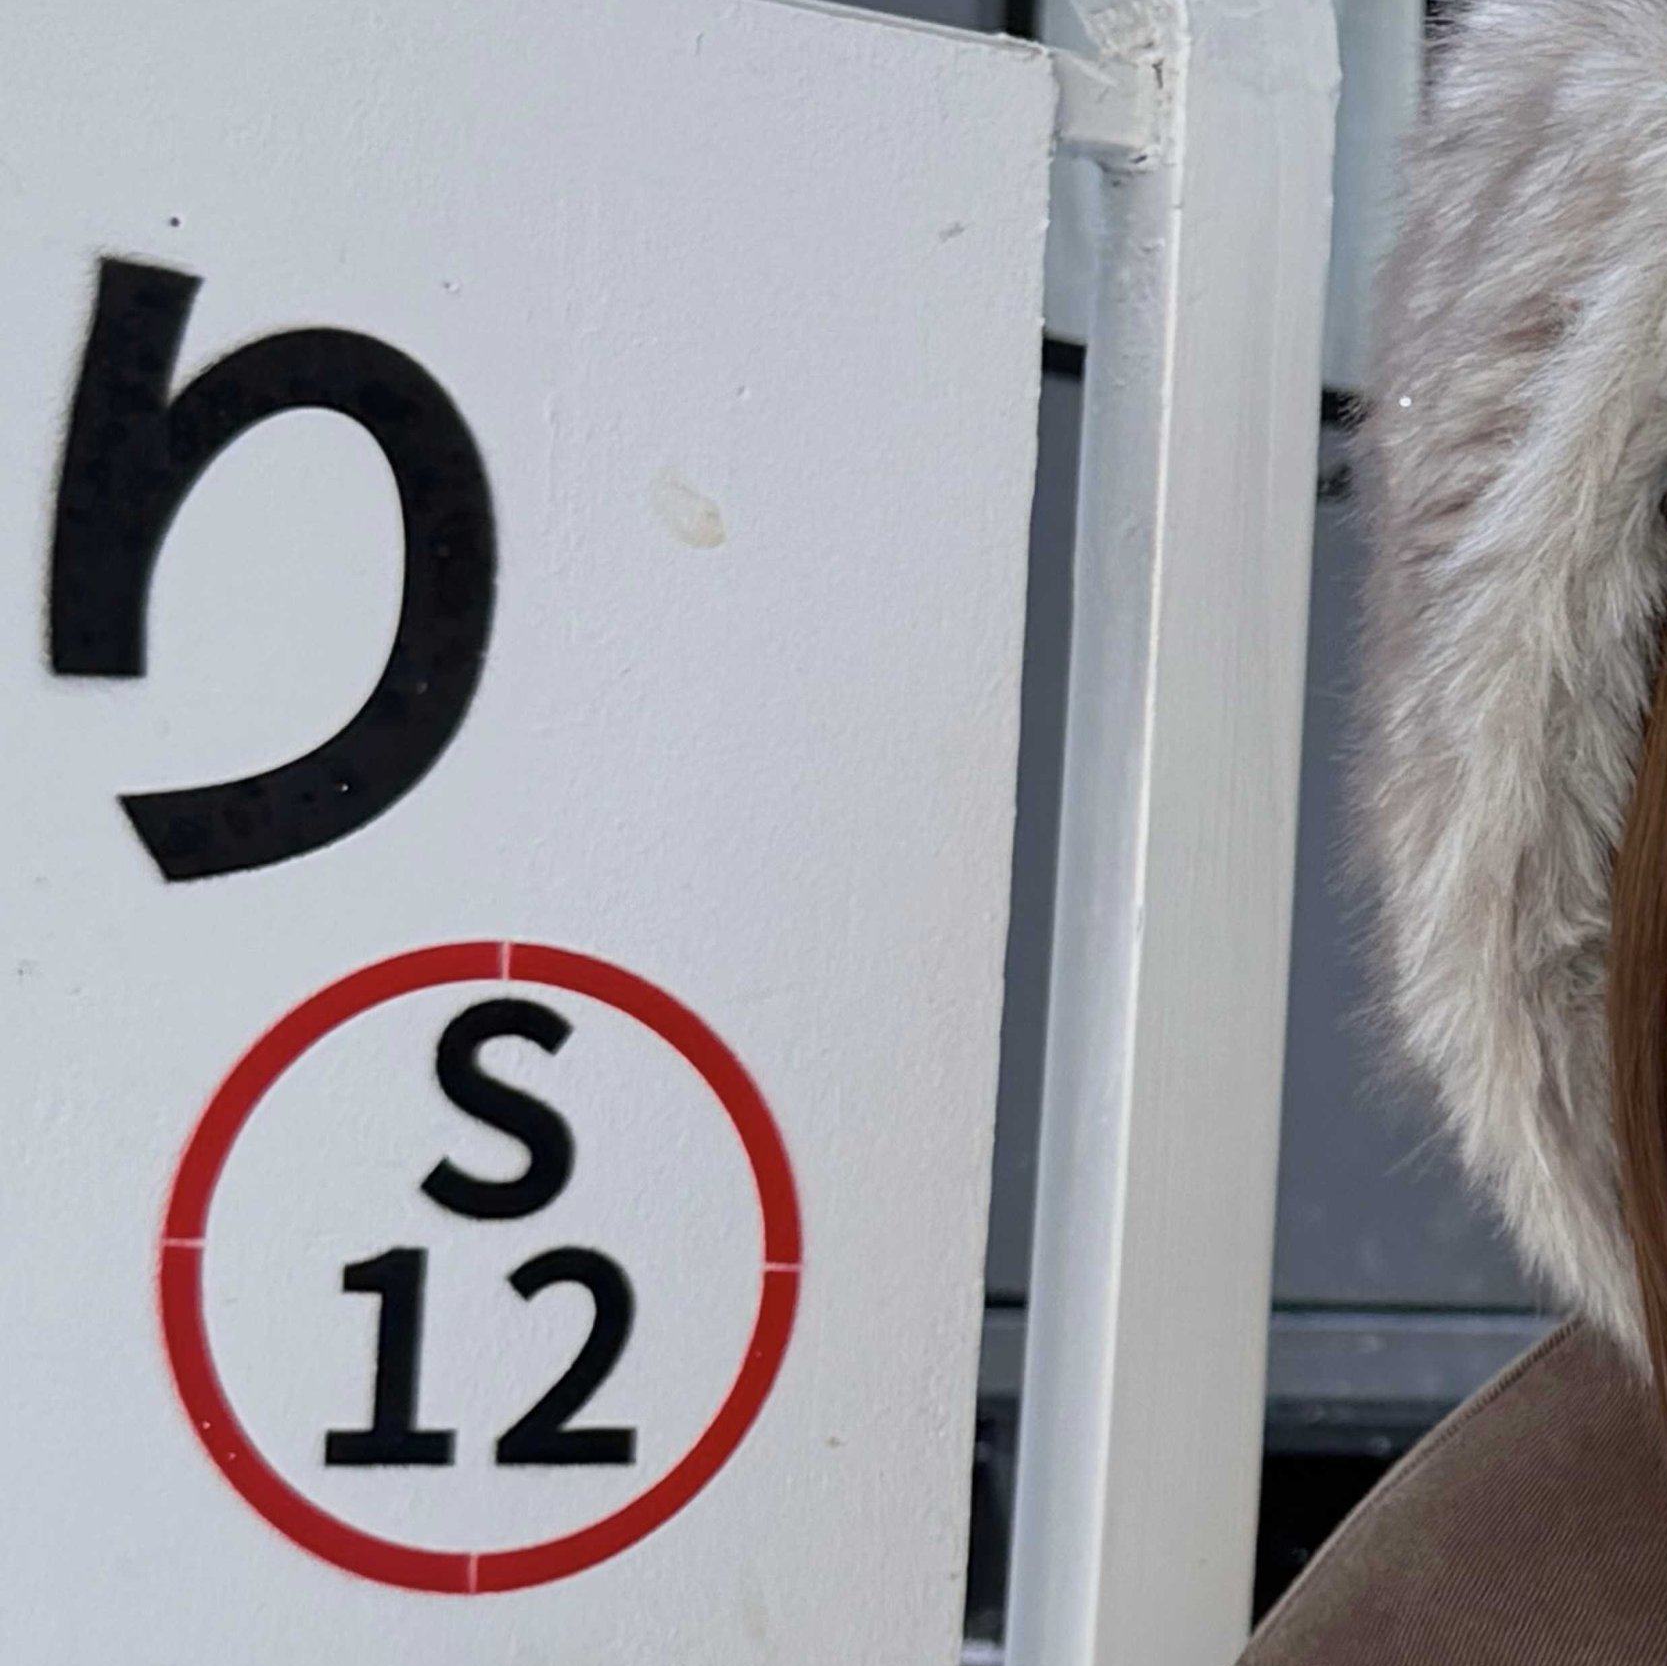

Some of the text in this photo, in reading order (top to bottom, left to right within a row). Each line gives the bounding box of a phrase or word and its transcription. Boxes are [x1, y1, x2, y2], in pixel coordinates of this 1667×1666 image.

[48, 255, 498, 883] り
[419, 997, 577, 1221] S
[323, 1246, 638, 1467] 12
